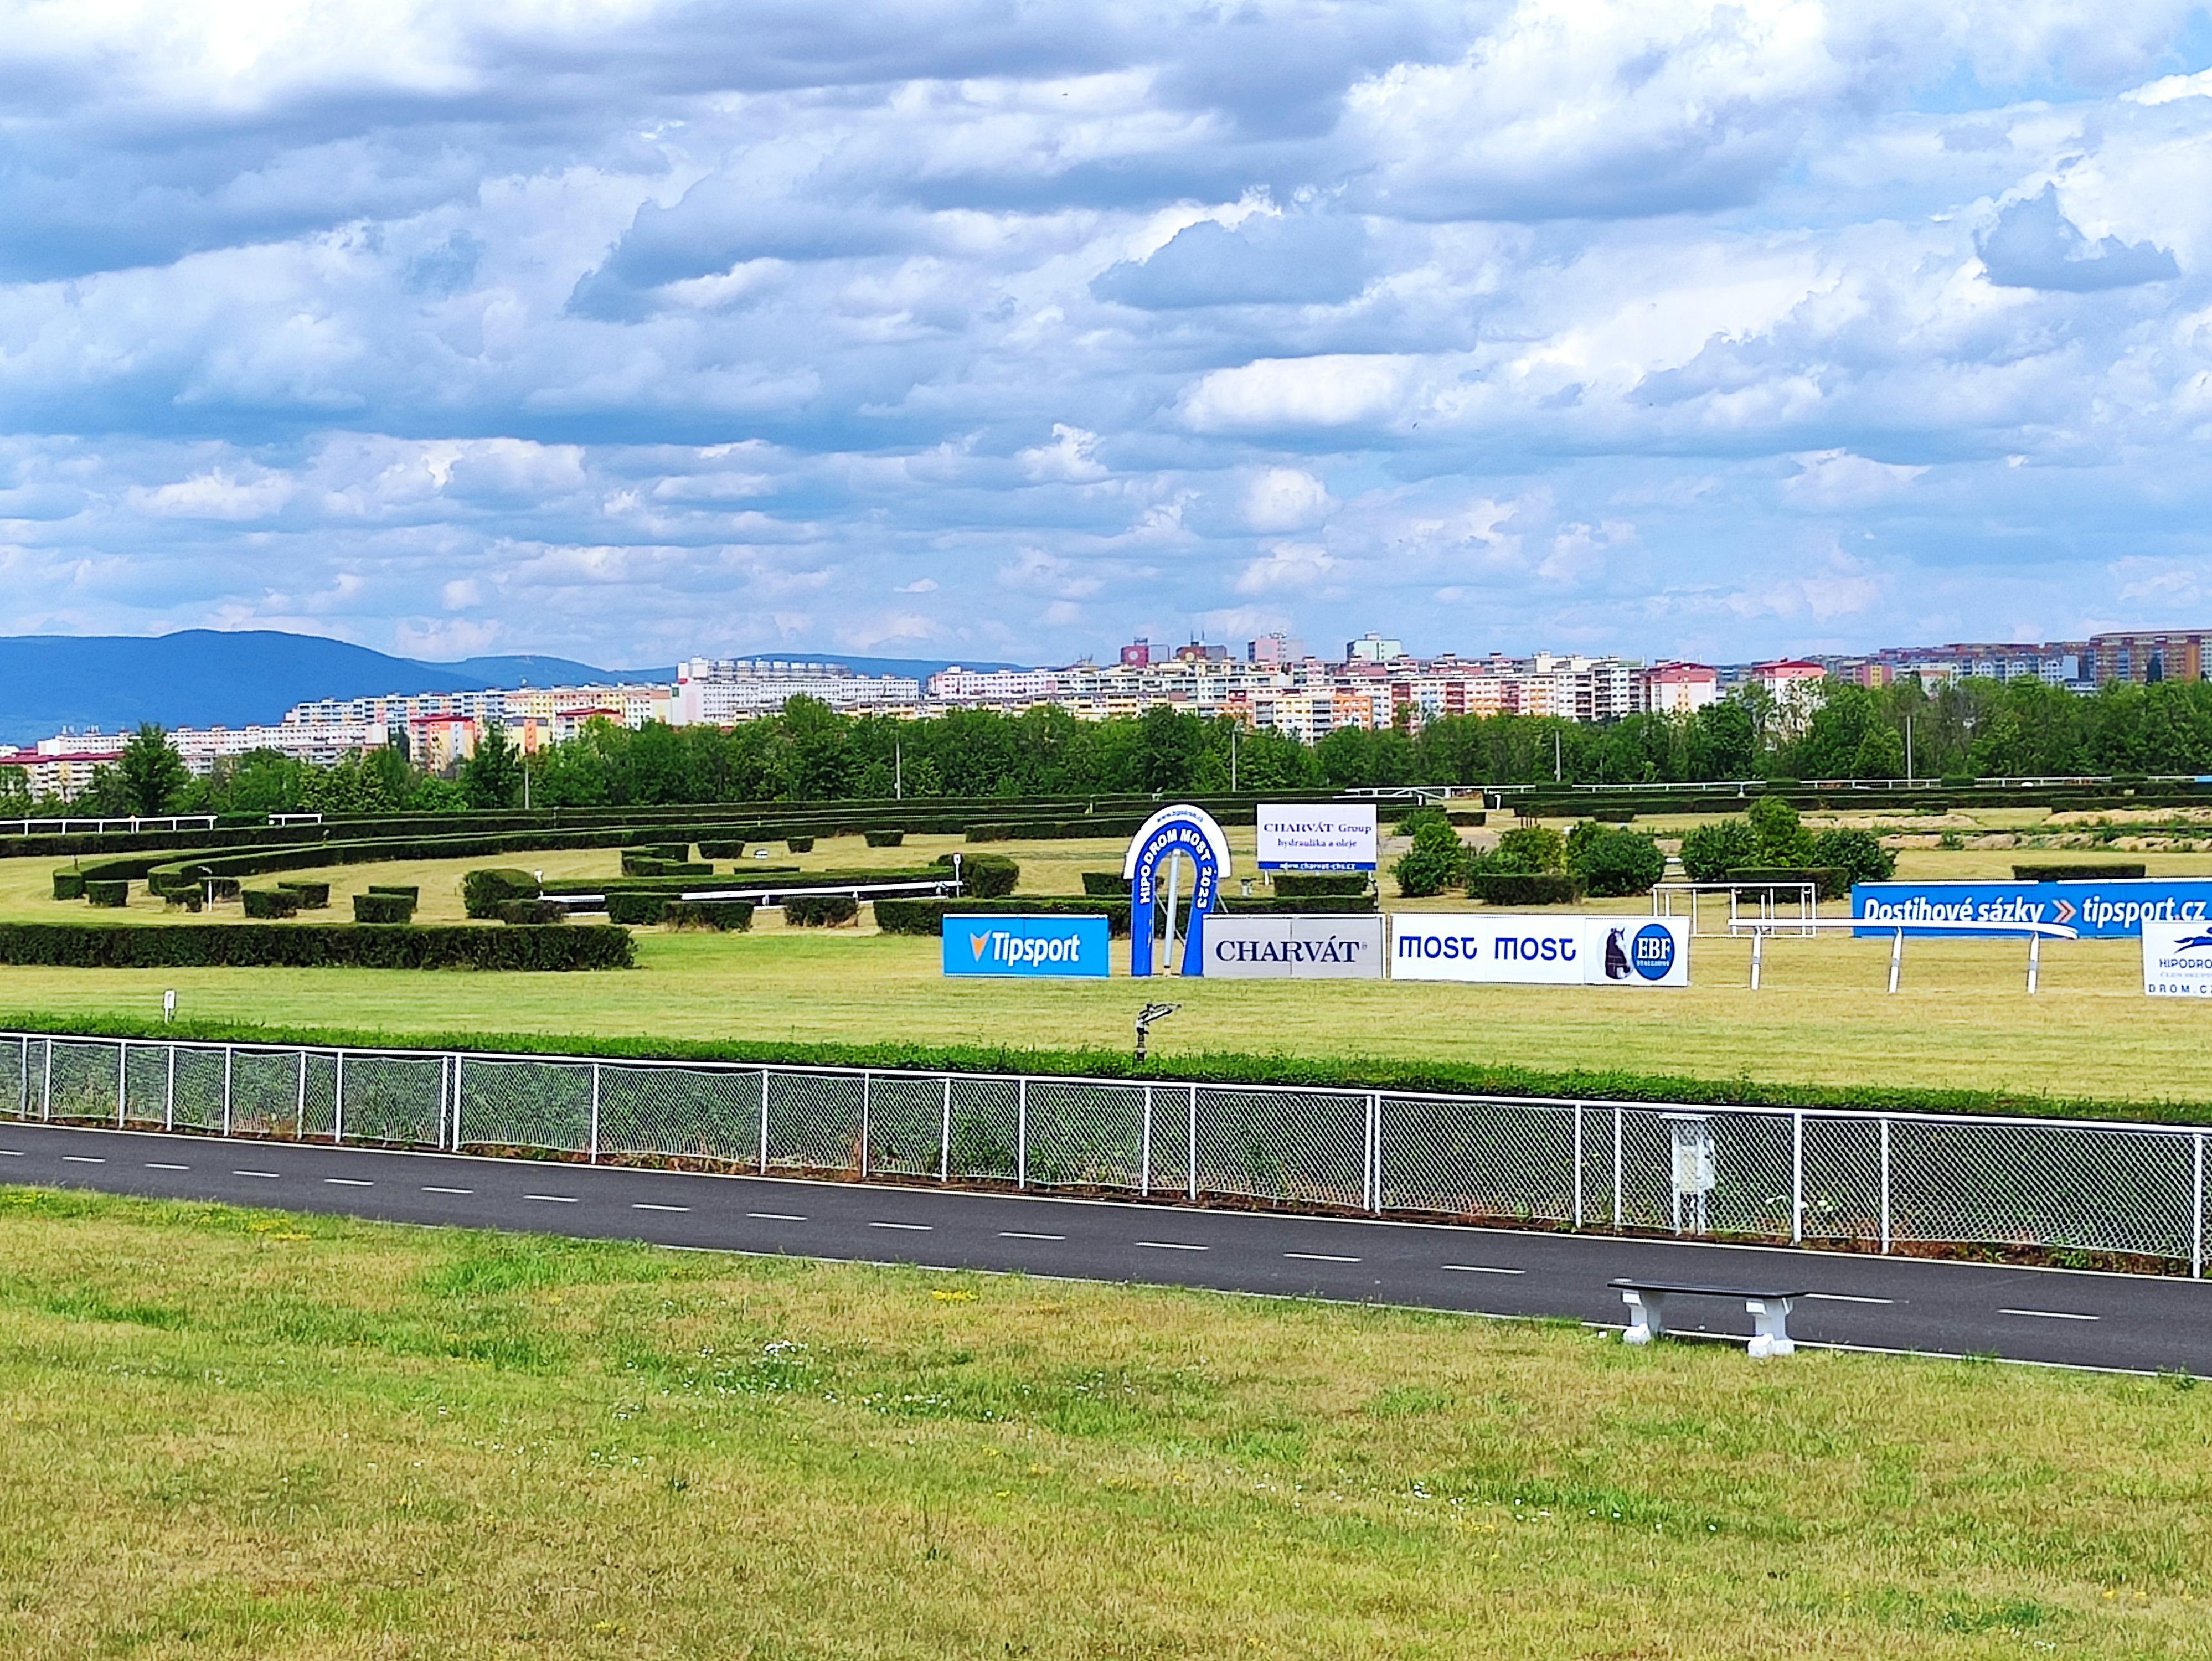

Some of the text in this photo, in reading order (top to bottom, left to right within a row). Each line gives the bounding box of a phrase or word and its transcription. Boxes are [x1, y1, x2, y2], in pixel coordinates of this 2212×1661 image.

[1264, 822, 1371, 834] CHARVÁT Group
[1278, 838, 1326, 848] hydraulika
[1336, 839, 1357, 848] oleje
[1180, 829, 1211, 861] MOST
[1197, 866, 1212, 908] 2023
[1864, 896, 2045, 922] Dostihové sázky
[2083, 895, 2206, 928] tipsport.cz
[992, 932, 1080, 967] Tipsport
[1216, 935, 1360, 962] CHARVÁT
[1637, 937, 1671, 959] EBF
